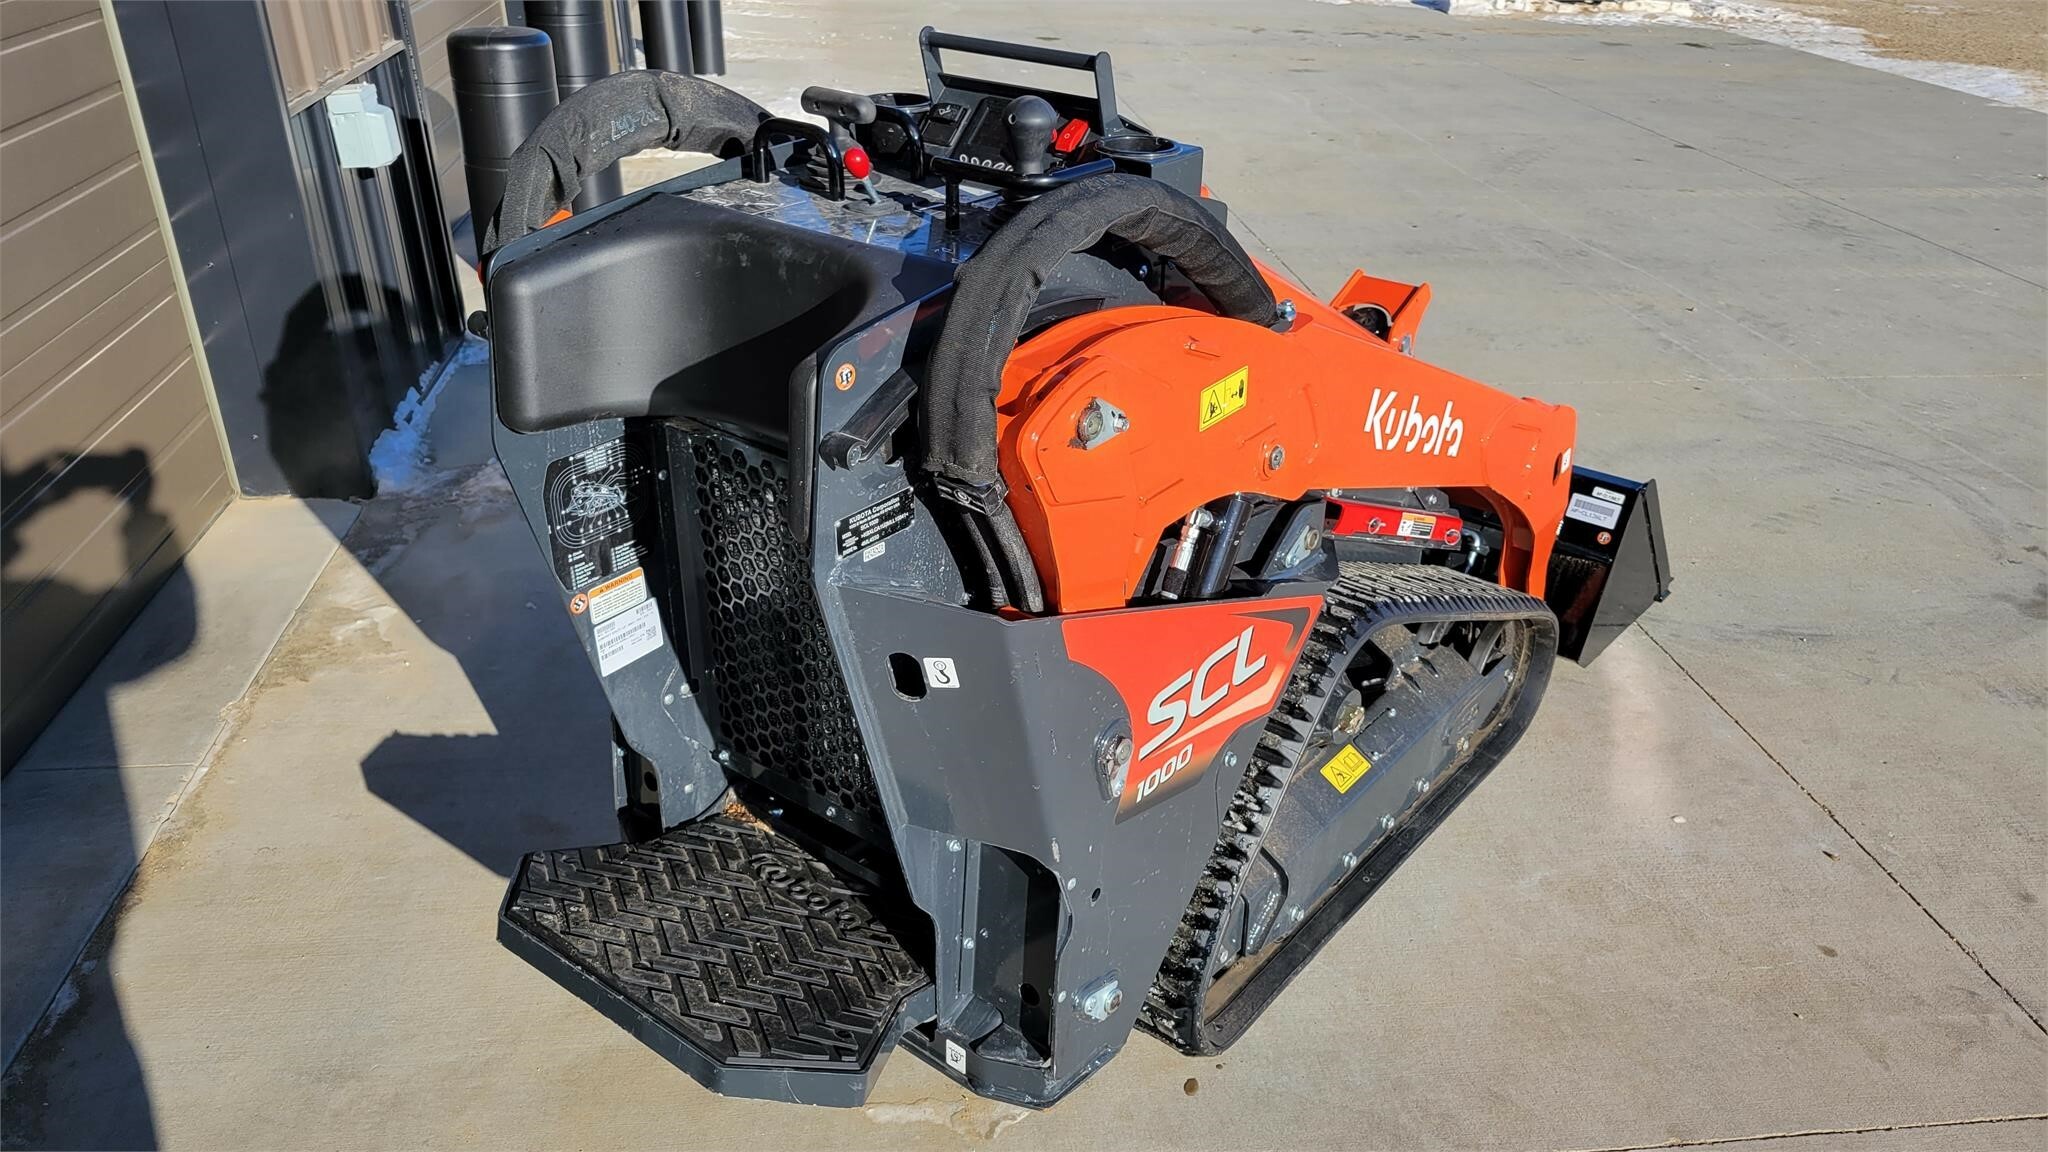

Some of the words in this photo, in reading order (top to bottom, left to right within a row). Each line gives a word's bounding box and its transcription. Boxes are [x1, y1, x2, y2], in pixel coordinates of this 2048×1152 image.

[1363, 387, 1464, 458] Kubota
[605, 573, 633, 590] WARNING
[1138, 625, 1267, 762] SCL
[1136, 743, 1193, 804] 1000
